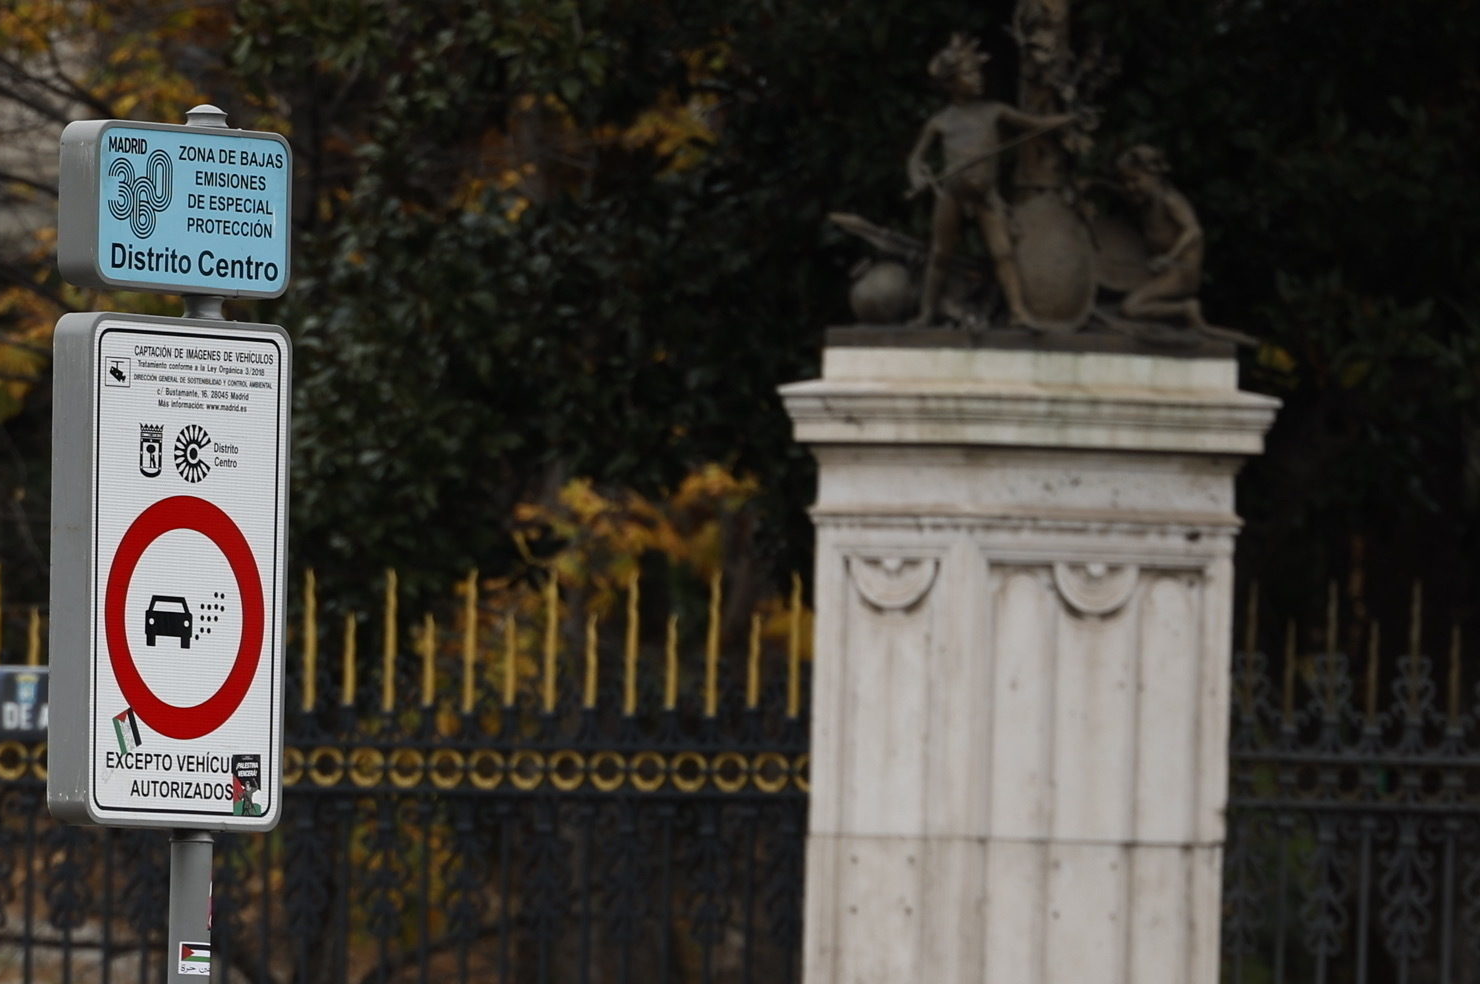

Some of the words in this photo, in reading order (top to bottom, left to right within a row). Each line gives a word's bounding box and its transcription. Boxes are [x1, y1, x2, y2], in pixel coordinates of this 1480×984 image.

[108, 136, 148, 155] MADRID
[179, 145, 215, 164] ZONA
[219, 149, 236, 165] DE
[241, 151, 283, 169] BAJAS
[195, 171, 266, 191] EMISIONES
[188, 194, 205, 209] DE
[209, 195, 273, 216] ESPECIAL
[187, 217, 272, 239] PROTECCIÓN
[111, 242, 191, 274] Distrito
[198, 250, 278, 282] Centro
[134, 345, 172, 358] CAPTACIÓN
[174, 348, 184, 358] DE
[186, 347, 221, 361] IMÁGENES
[224, 351, 233, 362] DE
[235, 350, 274, 365] VEHÍCULOS
[138, 360, 167, 369] Tratamiento
[169, 362, 193, 371] conforme
[207, 364, 217, 373] Ley
[219, 365, 243, 375] Orgánica
[245, 367, 265, 377] 3/2018
[133, 373, 157, 381] DIRECCIÓN
[159, 375, 178, 383] GENERAL
[227, 380, 248, 388] CONTROL
[249, 381, 273, 390] AMBIENTAL
[165, 387, 199, 398] Bustamante,
[211, 390, 228, 399] 28045
[231, 391, 249, 400] Madrid
[158, 399, 169, 407] Más
[171, 400, 204, 410] información:
[206, 402, 247, 412] www.madrid.es
[214, 443, 238, 454] Distrito
[214, 456, 237, 468] Centro
[2, 702, 33, 730] DE
[106, 752, 172, 771] EXCEPTO
[176, 752, 233, 774] VEHÍCU
[130, 780, 233, 800] AUTORIZADOS
